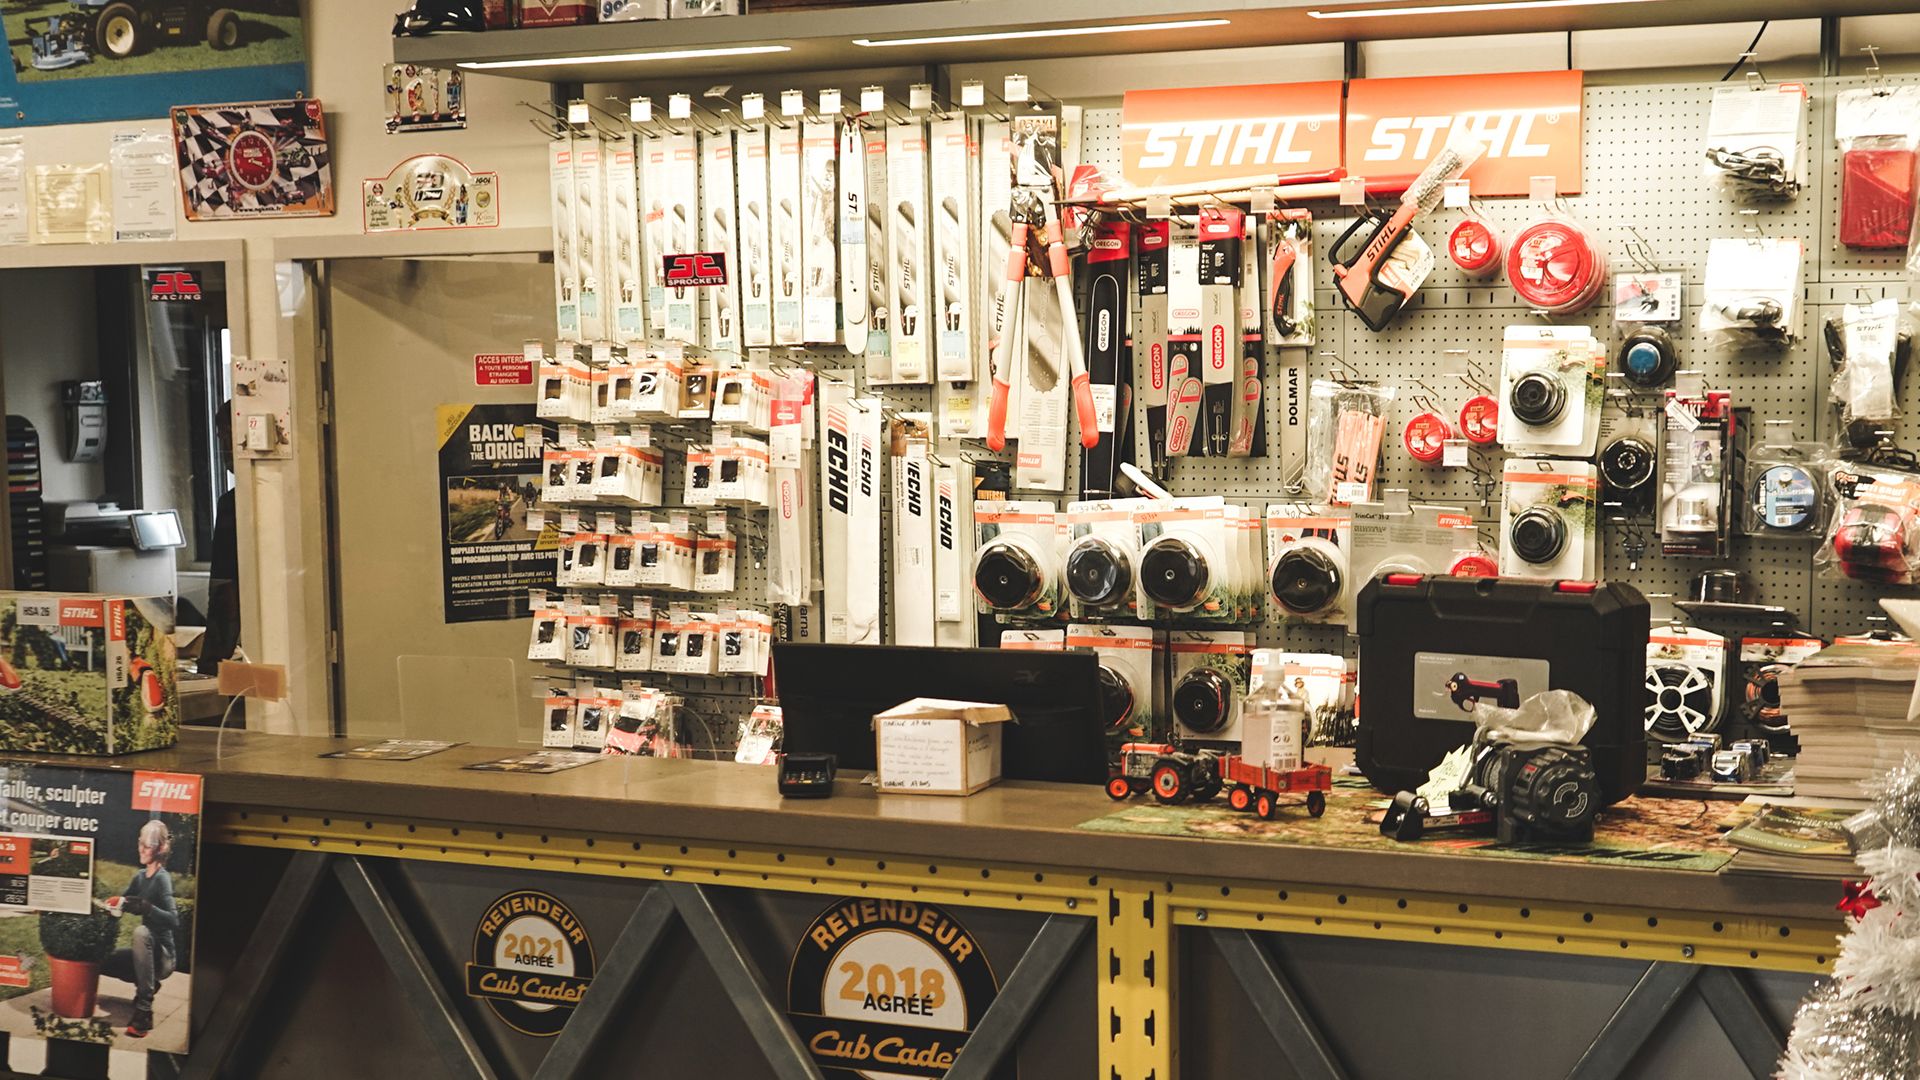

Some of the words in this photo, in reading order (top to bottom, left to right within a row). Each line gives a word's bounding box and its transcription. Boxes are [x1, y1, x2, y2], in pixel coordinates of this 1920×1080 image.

[1137, 121, 1312, 169] STIHL
[1363, 113, 1553, 161] STIHL
[1095, 240, 1120, 248] OREGON
[1366, 224, 1396, 262] STIHL
[667, 277, 724, 286] SPROCKETS
[872, 261, 880, 292] STIHL
[903, 259, 911, 290] STIHL
[948, 256, 956, 287] STIHL
[1100, 313, 1108, 349] OREGON
[478, 356, 500, 364] ACCES
[1214, 328, 1223, 367] OREGON
[1153, 347, 1162, 387] OREGON
[1289, 367, 1298, 426] DOLMAR
[469, 424, 516, 442] BACK
[472, 443, 483, 452] TO
[1172, 419, 1184, 450] OREGON
[470, 452, 485, 460] THE
[827, 428, 848, 515] ECHO
[861, 448, 872, 497] ECHO
[783, 481, 791, 518] OREGON
[907, 469, 922, 517] ECHO
[940, 495, 952, 550] ECHO
[1439, 517, 1463, 526] STIHL
[22, 606, 39, 617] HSA
[40, 606, 50, 617] 26
[62, 607, 98, 619] STIHL
[114, 605, 122, 637] STIHL
[116, 655, 123, 665] 26
[45, 785, 107, 808] sculpter
[139, 781, 192, 800] STIHL
[10, 812, 64, 832] couper
[64, 817, 99, 832] avec
[481, 896, 585, 945] REVENDEUR
[810, 898, 974, 964] REVENDEUR
[503, 933, 565, 965] 2021
[514, 953, 555, 969] AGRÉÉ
[479, 972, 520, 996] Cub
[521, 977, 588, 1003] Cadet
[839, 960, 946, 1010] 2018
[862, 993, 935, 1017] AGRÉÉ
[809, 1030, 872, 1061] Cub
[873, 1036, 965, 1070] Cade
